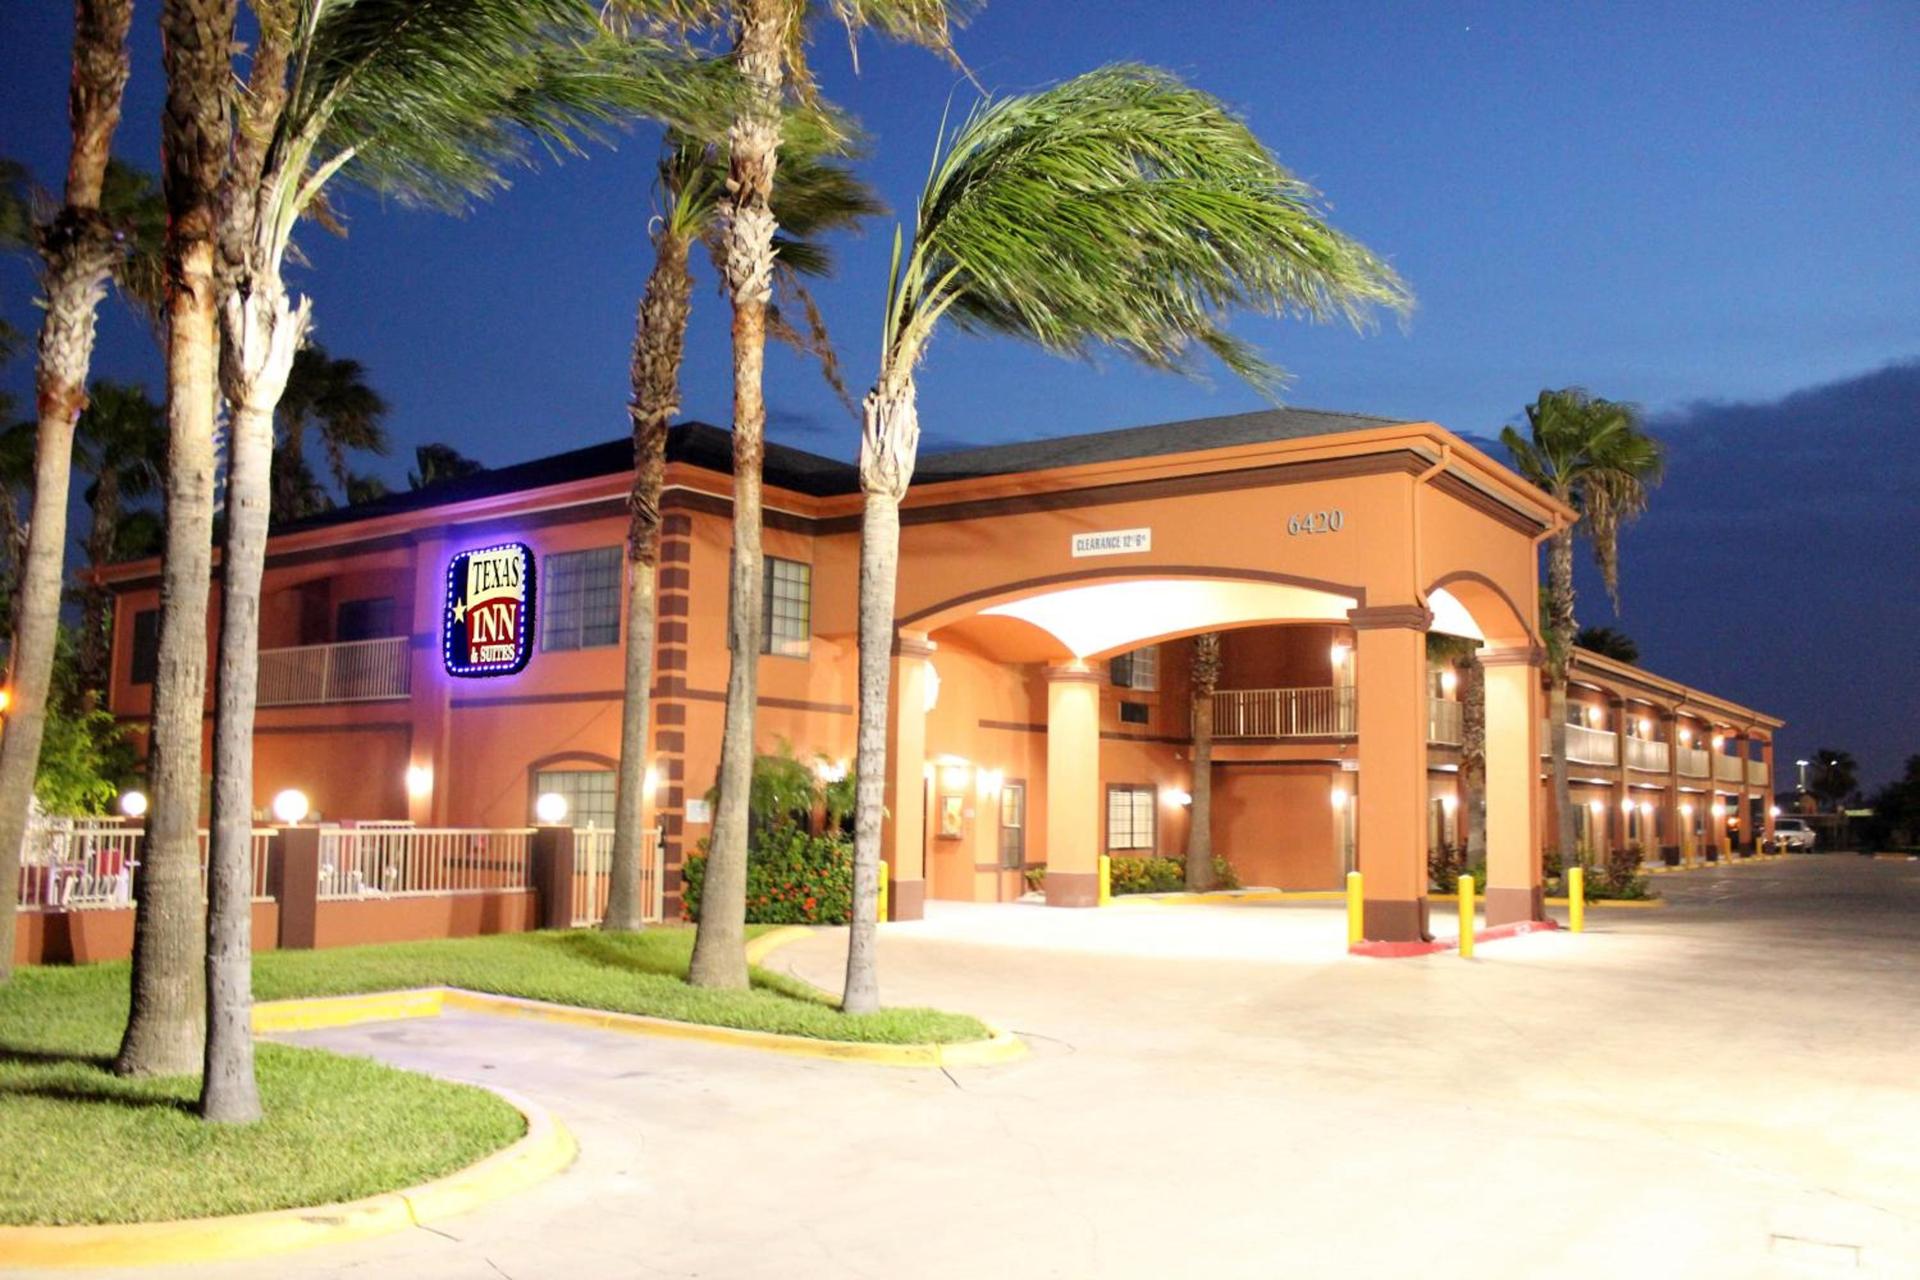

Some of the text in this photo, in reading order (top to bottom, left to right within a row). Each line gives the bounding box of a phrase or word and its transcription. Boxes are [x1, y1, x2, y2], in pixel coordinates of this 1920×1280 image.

[1288, 509, 1344, 535] 6420
[1077, 536, 1120, 551] CLEARANCE
[473, 556, 519, 595] TEXAS
[472, 603, 516, 643] INN
[470, 644, 515, 663] & SUITES
